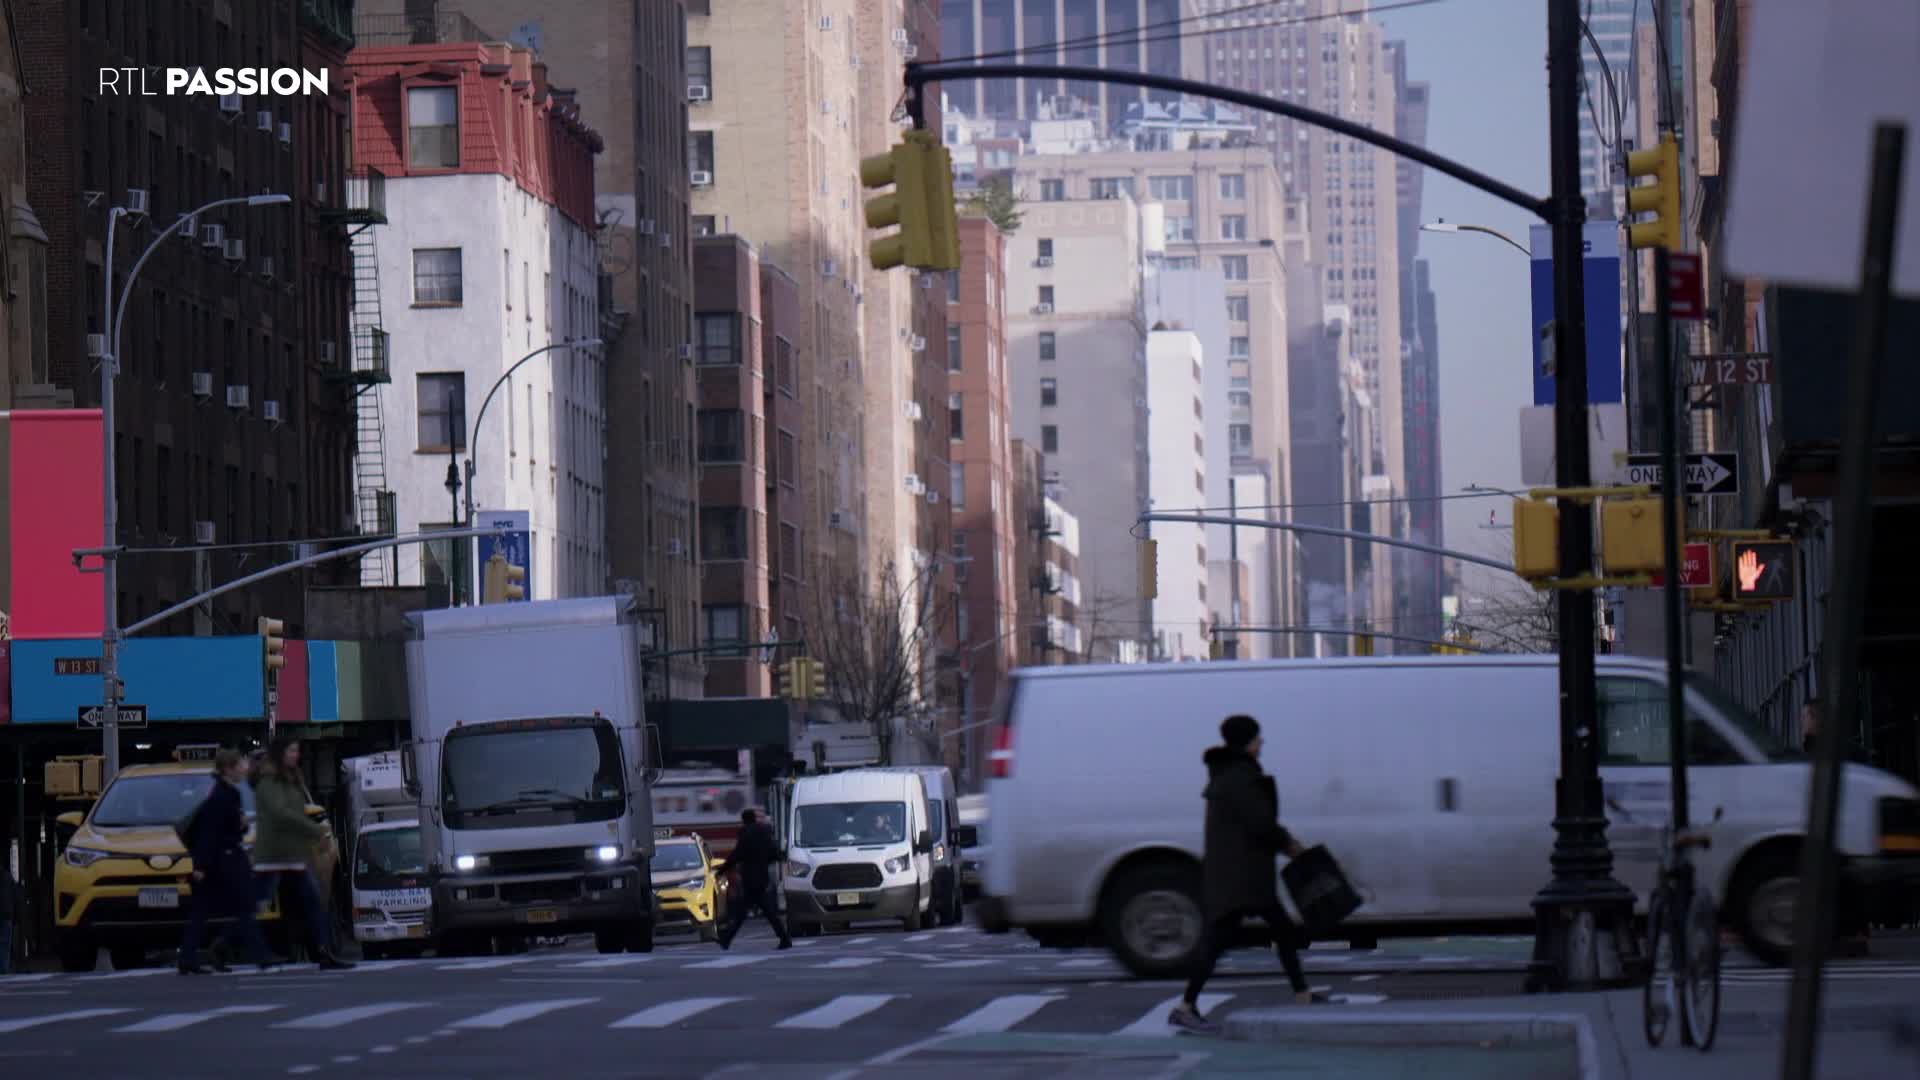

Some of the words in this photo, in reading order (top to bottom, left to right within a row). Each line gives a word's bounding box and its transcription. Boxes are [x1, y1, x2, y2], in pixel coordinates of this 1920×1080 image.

[1690, 359, 1706, 383] W
[1716, 359, 1736, 383] 12
[1745, 358, 1769, 383] ST
[58, 660, 66, 673] W
[71, 660, 81, 673] 13
[86, 660, 97, 673] ST
